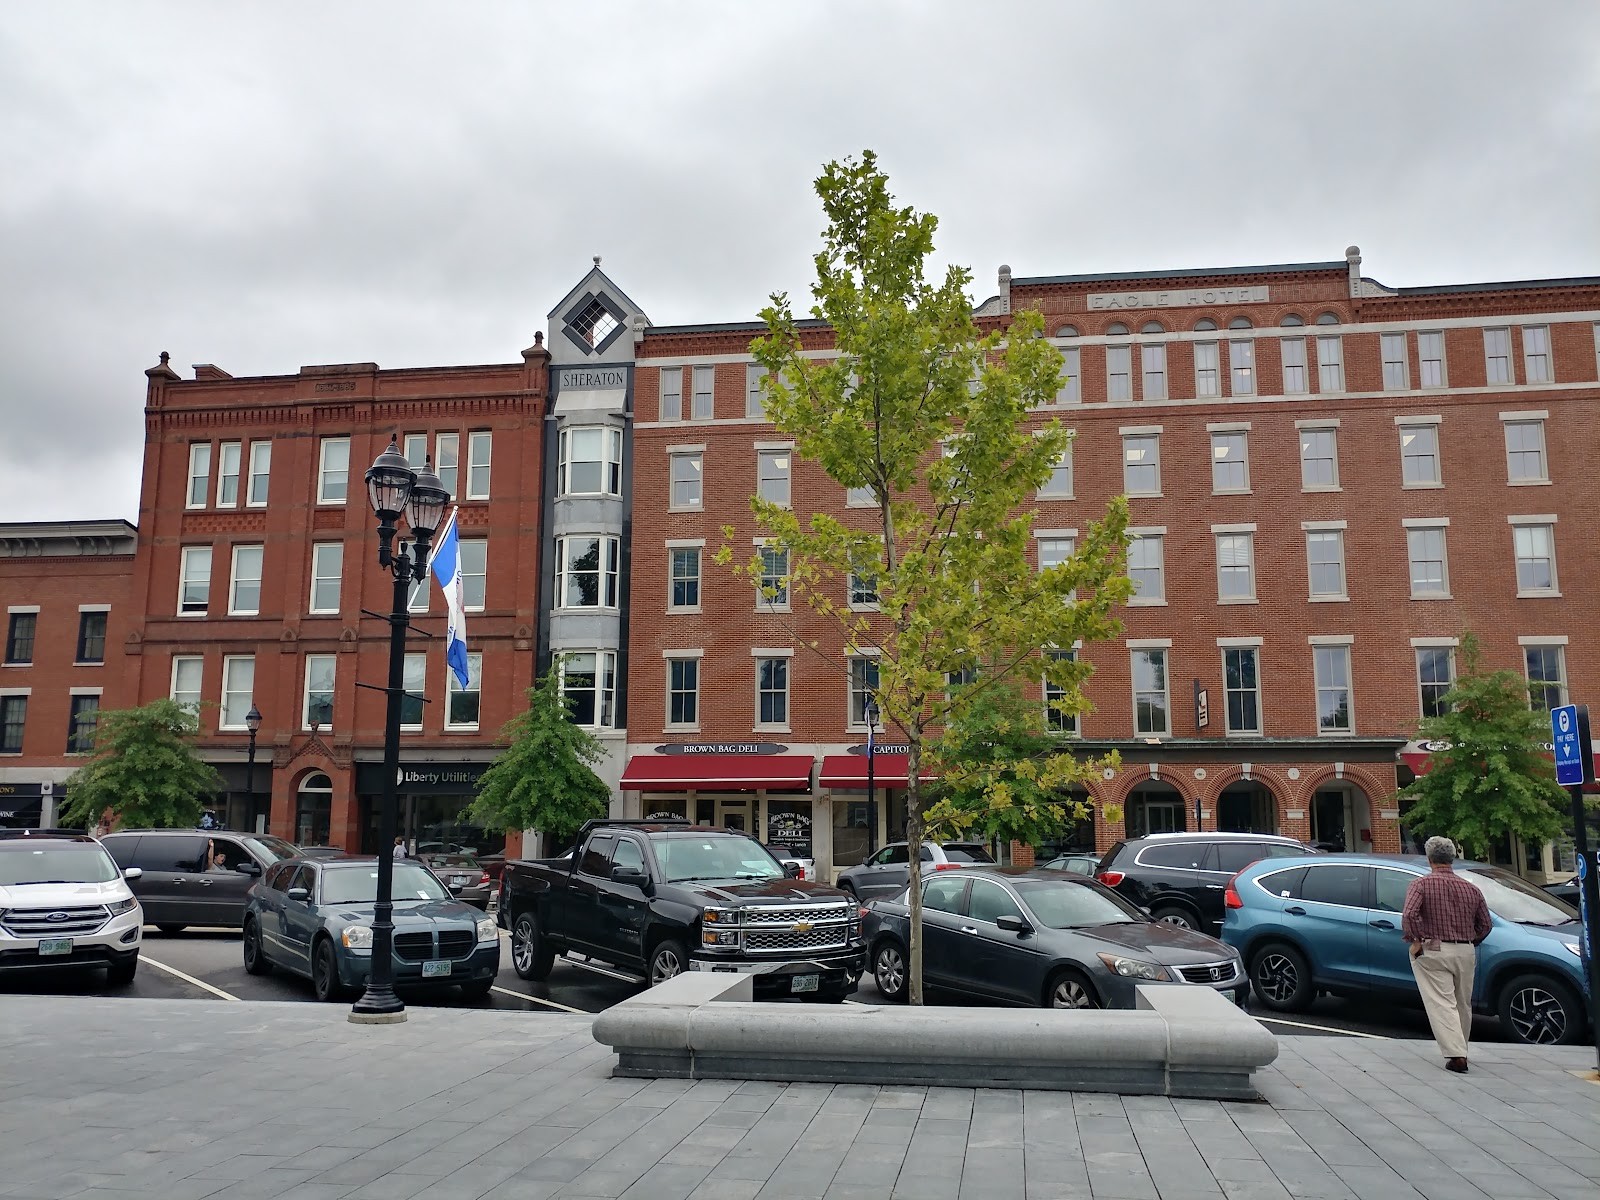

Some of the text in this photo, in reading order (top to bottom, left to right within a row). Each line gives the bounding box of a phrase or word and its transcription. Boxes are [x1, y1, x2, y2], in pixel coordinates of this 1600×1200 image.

[1092, 289, 1265, 309] EAGLE HOTEL
[563, 372, 624, 387] SHERATON
[1556, 733, 1575, 743] PAY HERE
[683, 745, 758, 753] BROWN BAG DELI
[405, 771, 439, 785] Liberty
[770, 812, 810, 826] BROWN BAG
